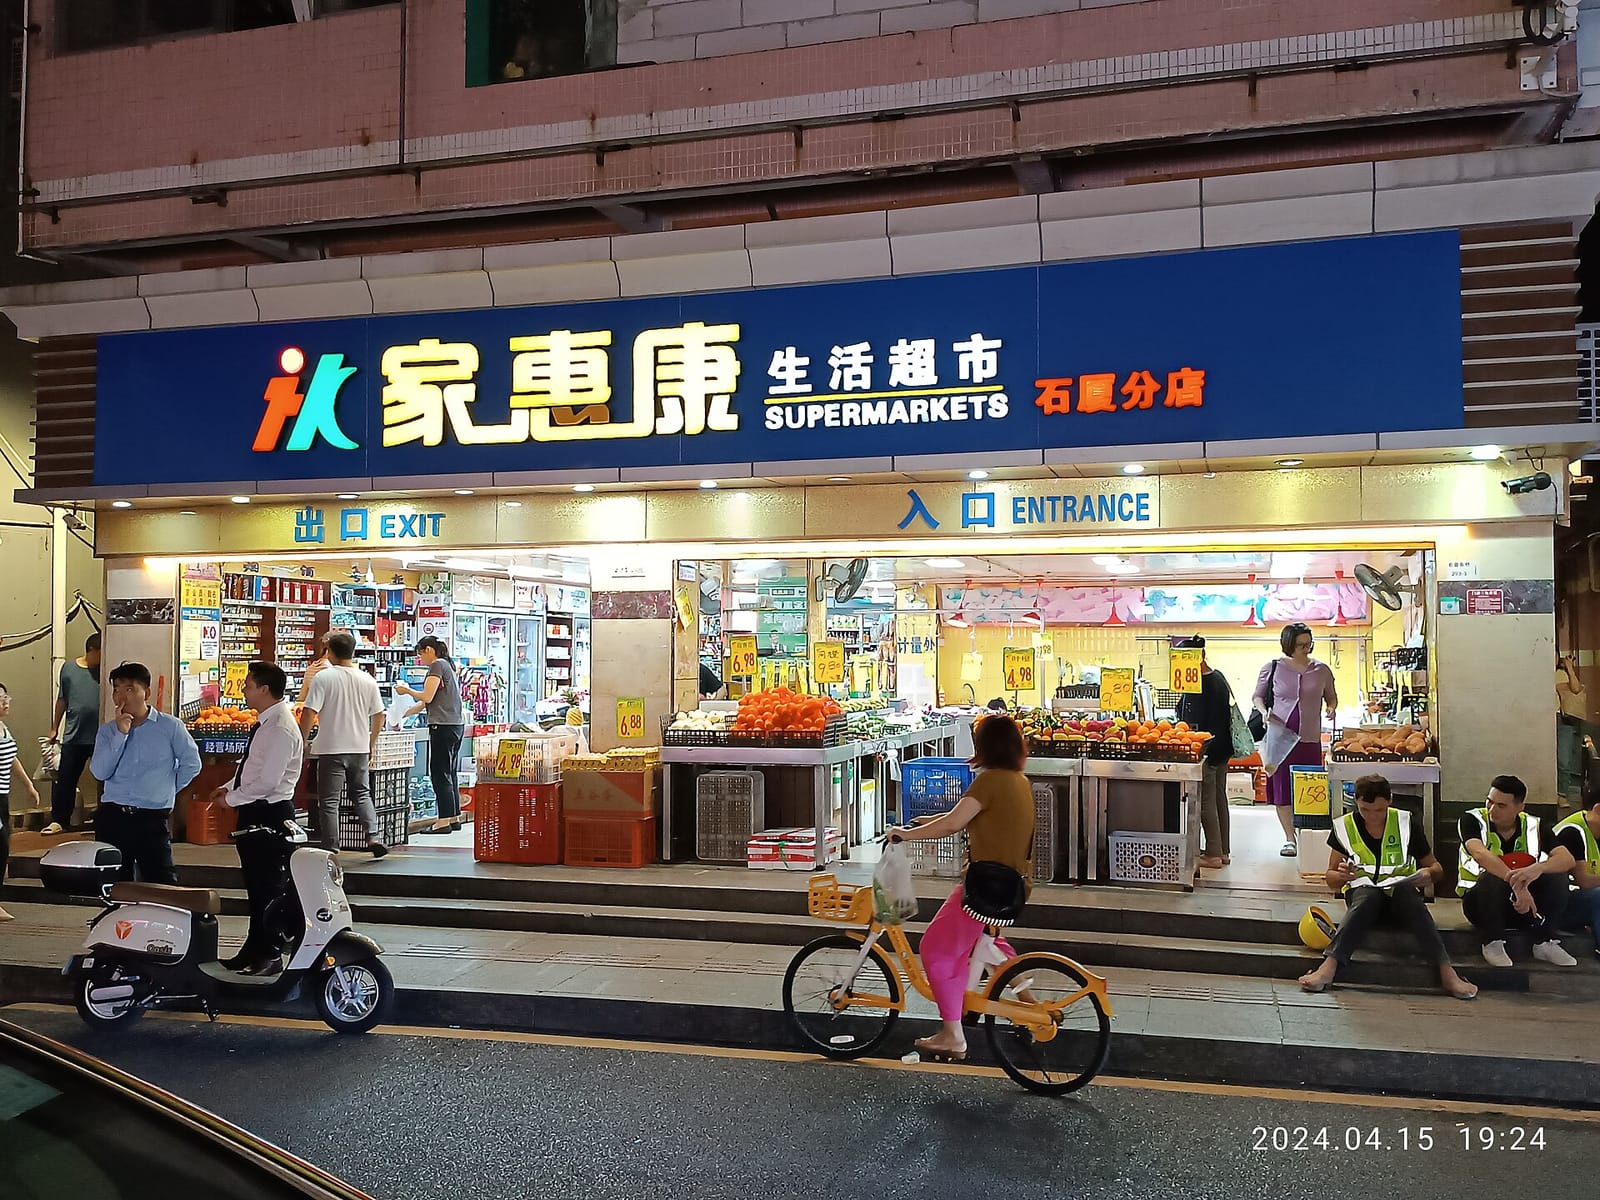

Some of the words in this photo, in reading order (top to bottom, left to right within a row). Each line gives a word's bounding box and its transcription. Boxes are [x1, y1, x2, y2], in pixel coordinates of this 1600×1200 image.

[766, 332, 1003, 395] 生活超市
[380, 320, 741, 449] 家惠康
[1034, 366, 1207, 416] 石厦分店
[764, 391, 1010, 431] SUPERMARKETS
[896, 488, 996, 529] 入口
[1011, 492, 1151, 525] ENTRANCE
[293, 506, 369, 544] 出口
[380, 512, 447, 539] EXIT
[732, 652, 755, 673] 6.98
[1007, 666, 1032, 688] 4.98
[1174, 667, 1199, 690] 8.88
[620, 714, 642, 736] 6.88
[205, 741, 249, 754] 经营场所
[497, 753, 522, 775] 4.98
